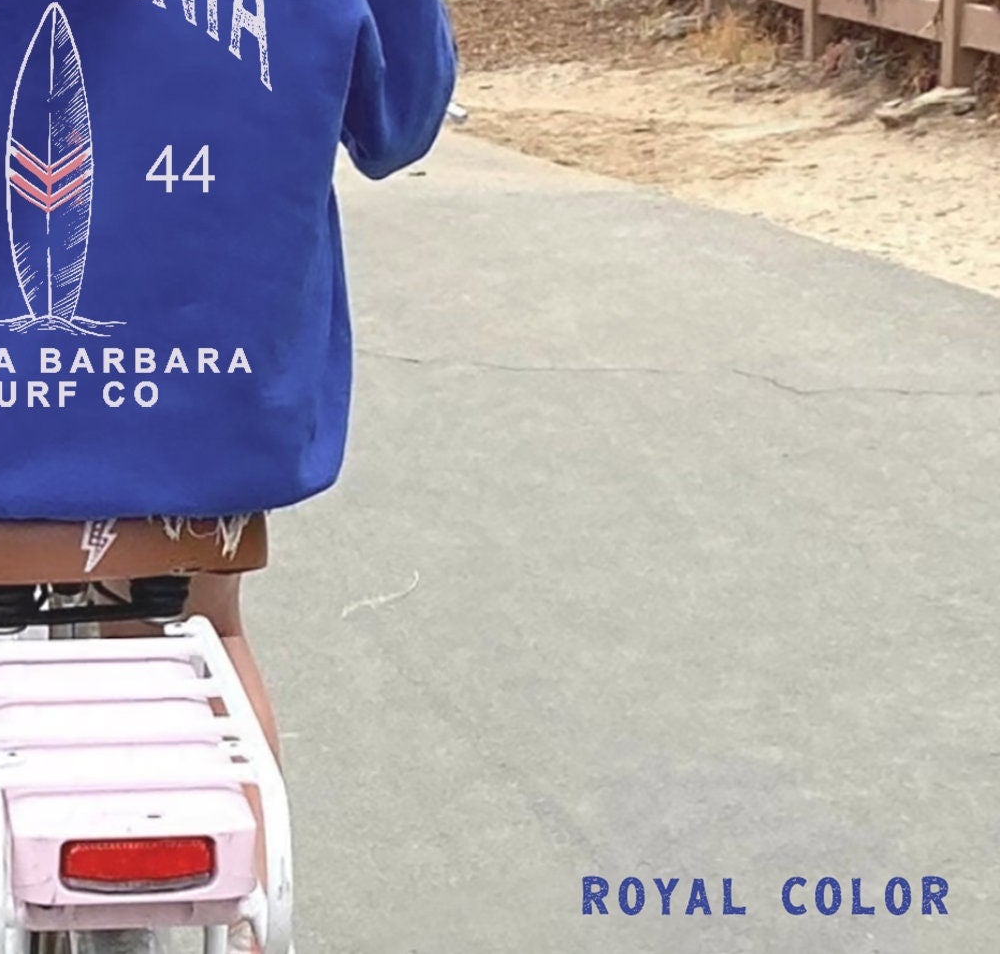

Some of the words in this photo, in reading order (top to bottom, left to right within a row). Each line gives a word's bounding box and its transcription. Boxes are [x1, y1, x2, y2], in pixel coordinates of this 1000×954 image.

[144, 144, 216, 194] 44
[39, 347, 253, 374] BARBARA
[102, 381, 160, 408] CO
